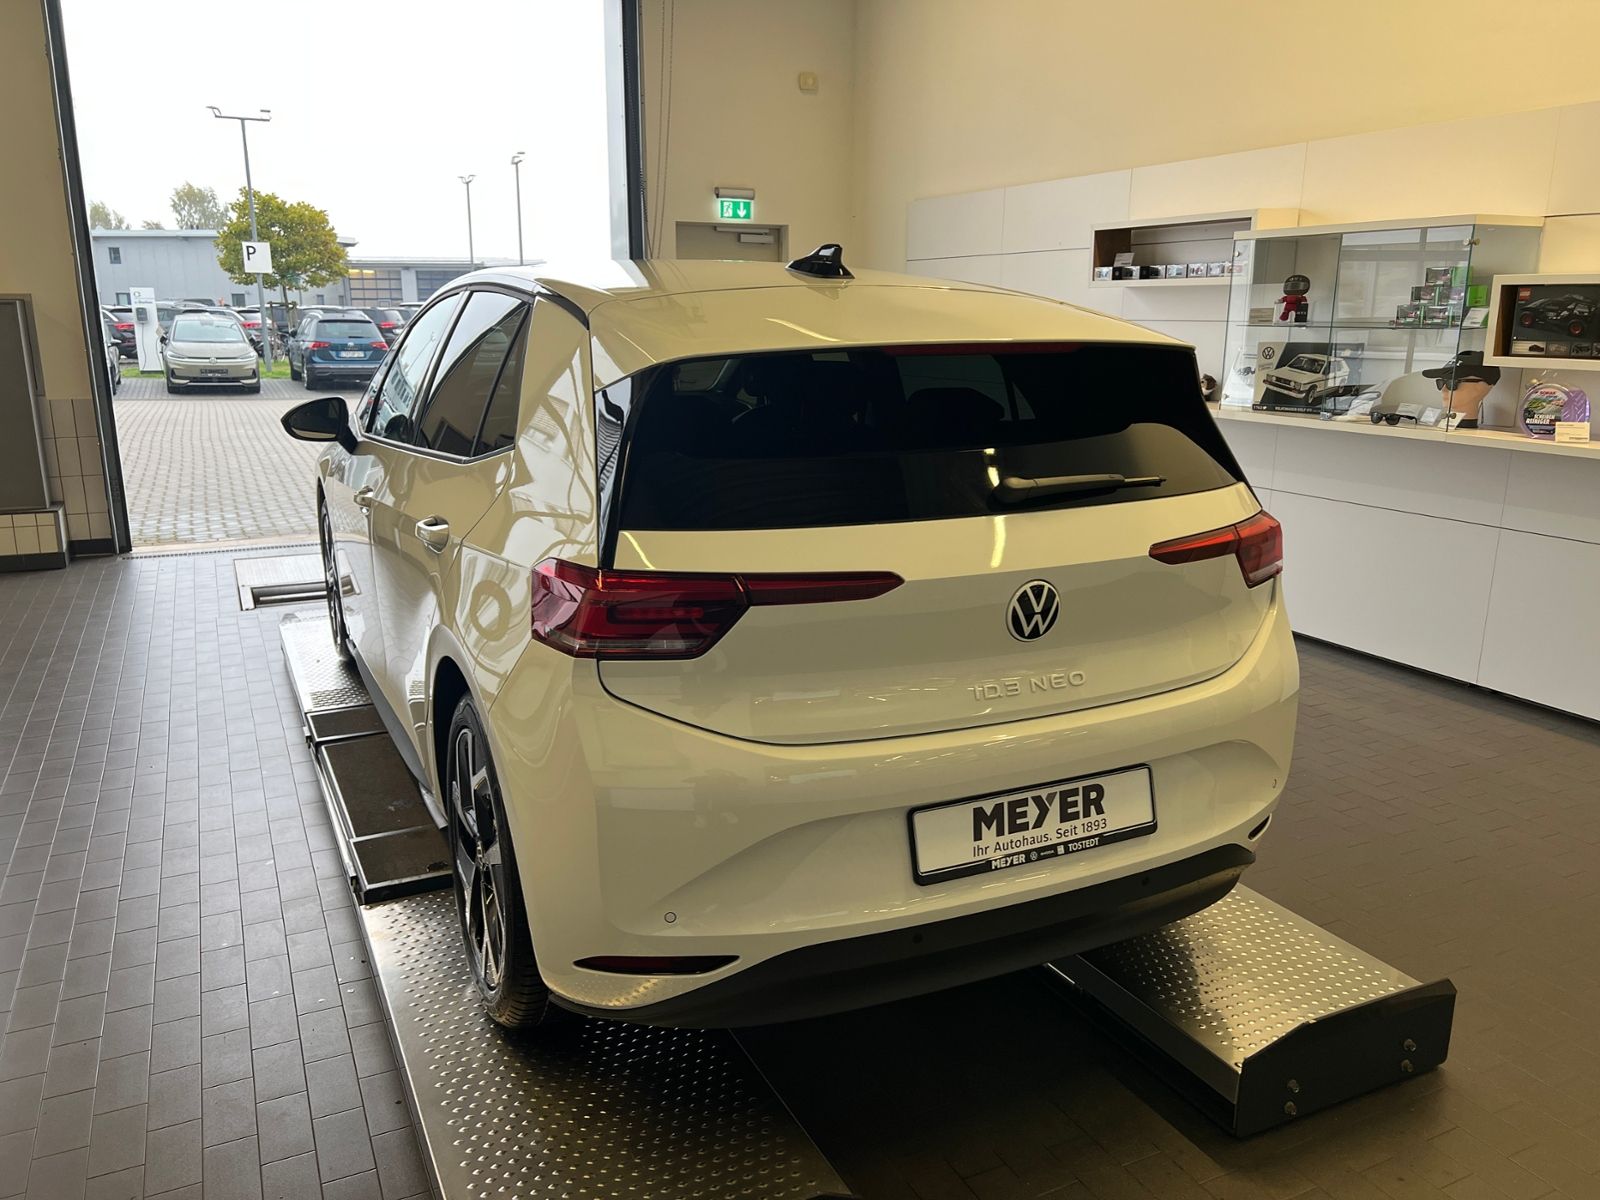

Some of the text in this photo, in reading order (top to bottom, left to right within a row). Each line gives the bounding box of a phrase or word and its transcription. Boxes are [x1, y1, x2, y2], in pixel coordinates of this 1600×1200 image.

[246, 245, 257, 261] P
[973, 671, 1086, 701] ID.3 NEO
[973, 783, 1105, 842] MEYER
[973, 844, 990, 858] Ihr
[993, 833, 1053, 854] Autohaus.
[1055, 825, 1078, 840] Seit
[1081, 818, 1108, 834] 1893
[991, 853, 1026, 870] MEYER
[1067, 836, 1100, 852] TOSTEDT
